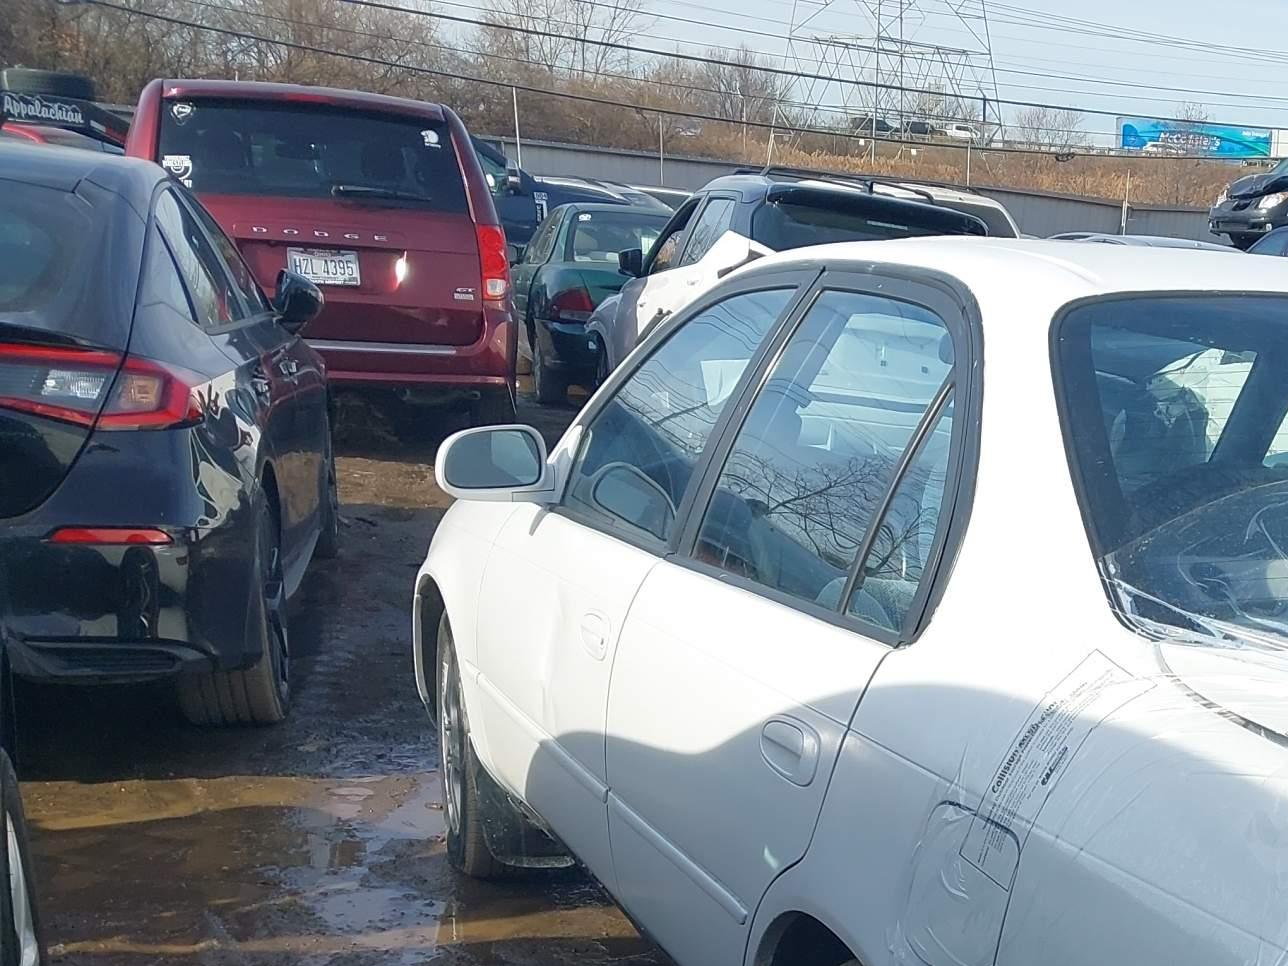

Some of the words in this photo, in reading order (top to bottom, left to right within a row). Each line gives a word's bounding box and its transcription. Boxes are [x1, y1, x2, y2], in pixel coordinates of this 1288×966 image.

[3, 95, 85, 123] Appalachian
[252, 226, 388, 242] DODGE
[294, 257, 318, 276] HZL
[321, 258, 354, 277] 4395
